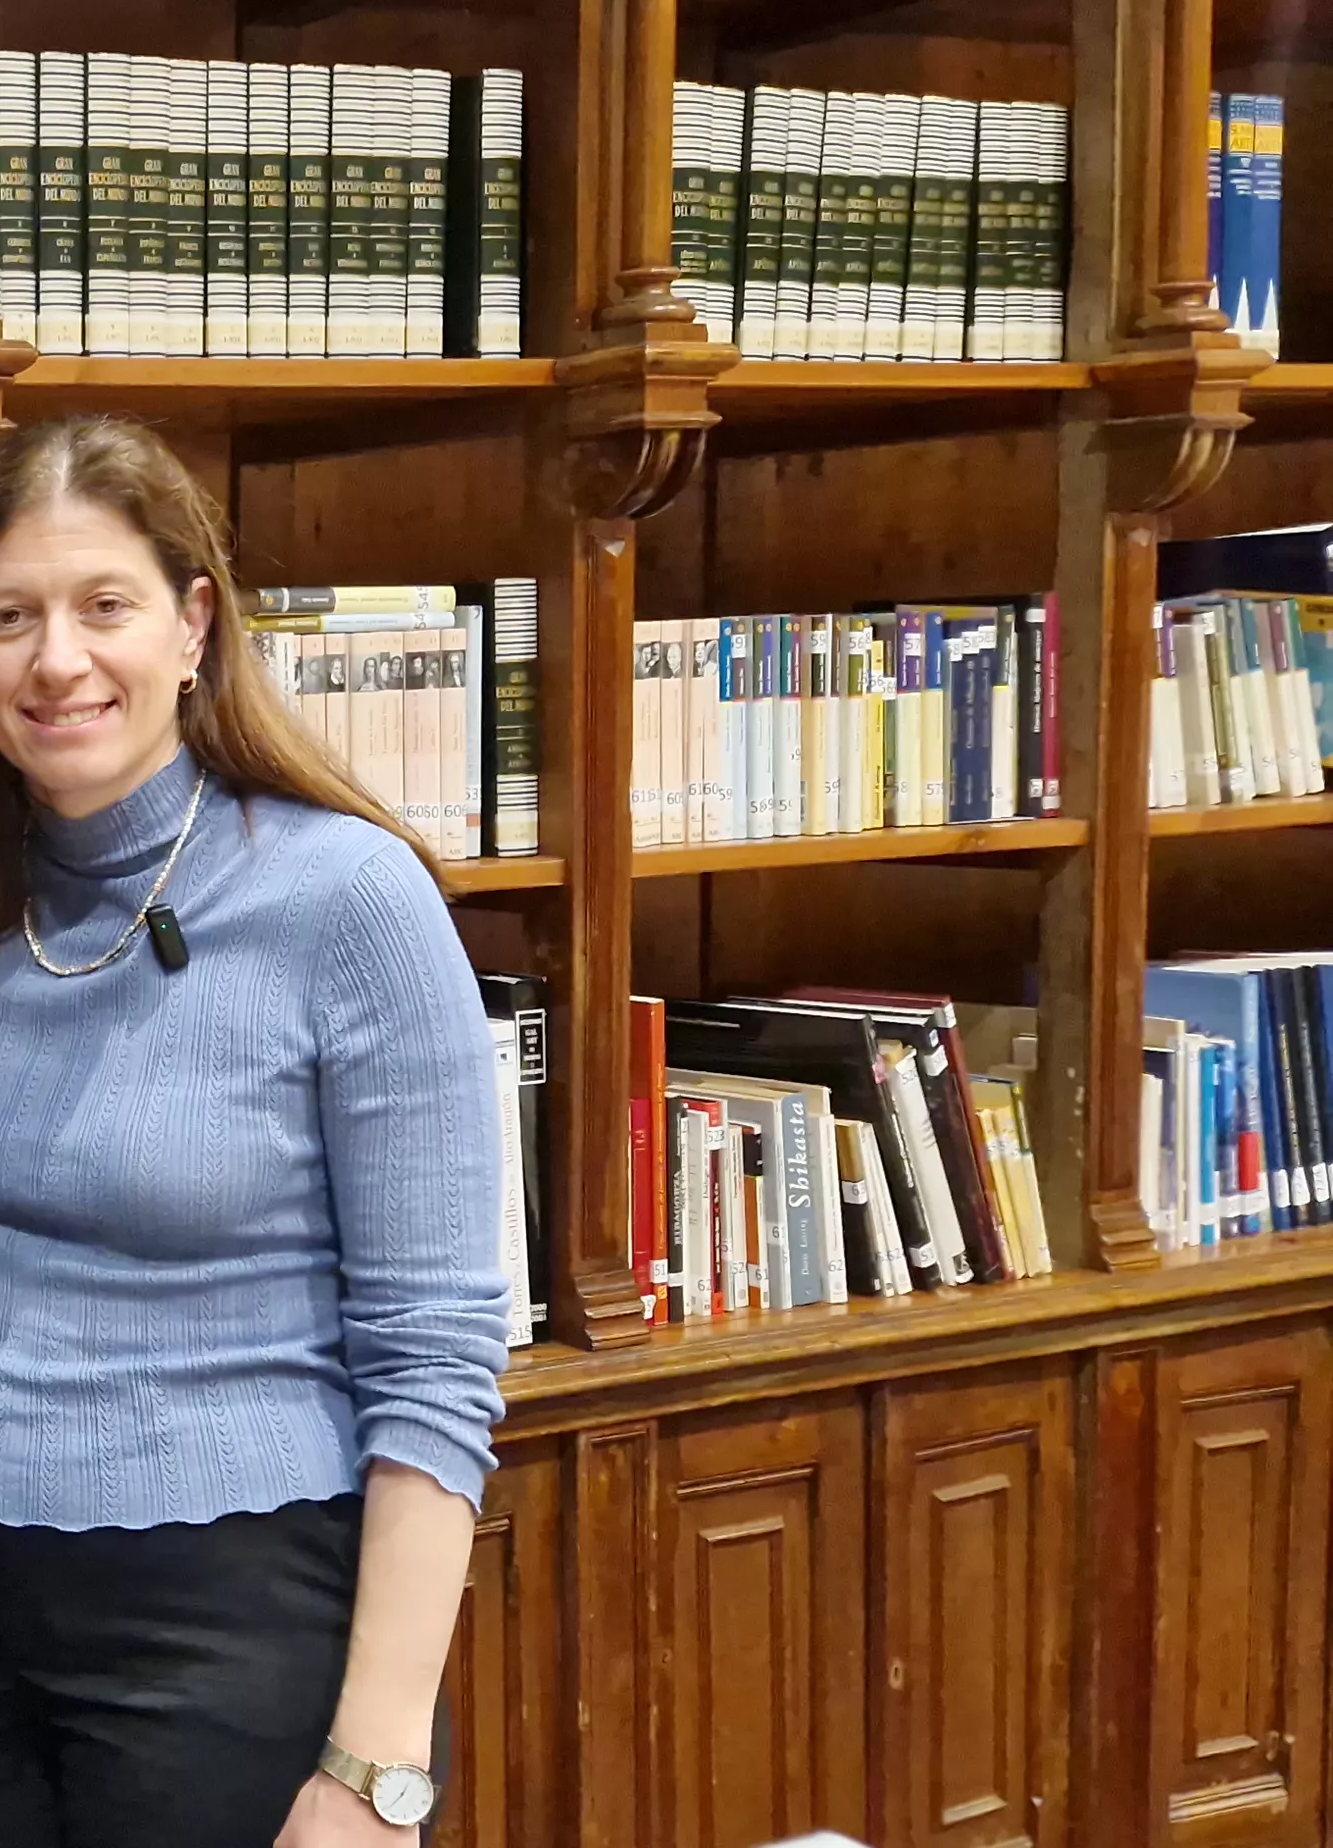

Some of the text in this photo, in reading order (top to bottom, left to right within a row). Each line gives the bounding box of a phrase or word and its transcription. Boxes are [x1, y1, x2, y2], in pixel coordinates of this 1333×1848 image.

[55, 156, 74, 170] GRAN
[45, 188, 59, 201] DEL
[92, 187, 106, 201] DEL
[788, 1101, 811, 1208] Shikasta
